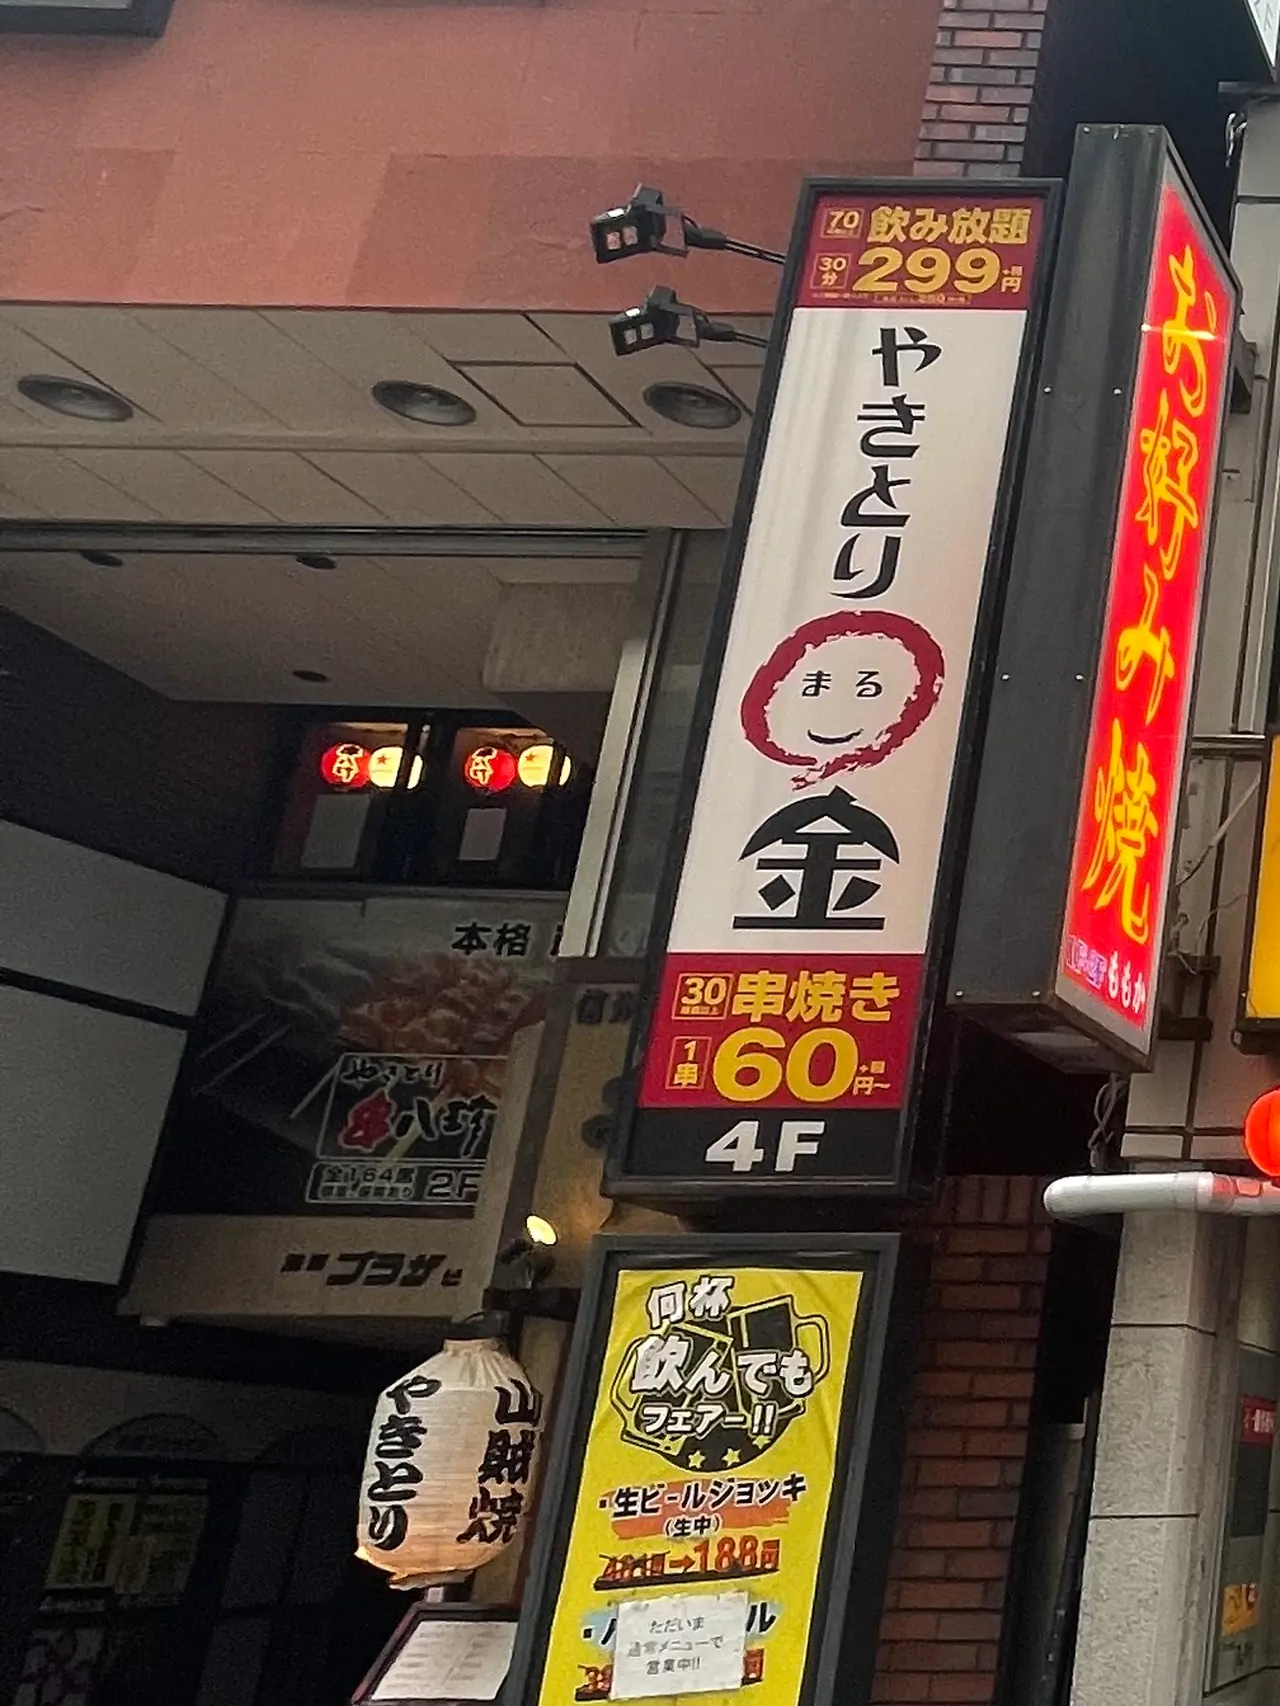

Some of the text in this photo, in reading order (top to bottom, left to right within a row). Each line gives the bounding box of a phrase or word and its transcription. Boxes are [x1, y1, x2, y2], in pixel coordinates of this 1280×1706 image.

[867, 205, 1032, 244] 飲み放題
[851, 245, 1001, 294] 299
[829, 326, 943, 600] やきとり
[801, 669, 884, 698] まる
[732, 785, 901, 931] 金
[731, 969, 901, 1024] 串焼き
[711, 1026, 860, 1103] 60
[704, 1120, 826, 1173] 4F
[646, 1273, 735, 1331] 何杯
[629, 1333, 816, 1399] 飲んでも
[364, 1375, 442, 1550] やきとり
[454, 1375, 544, 1547] 山賊焼
[663, 1517, 724, 1538] (生中)
[648, 1615, 706, 1635] ただいま
